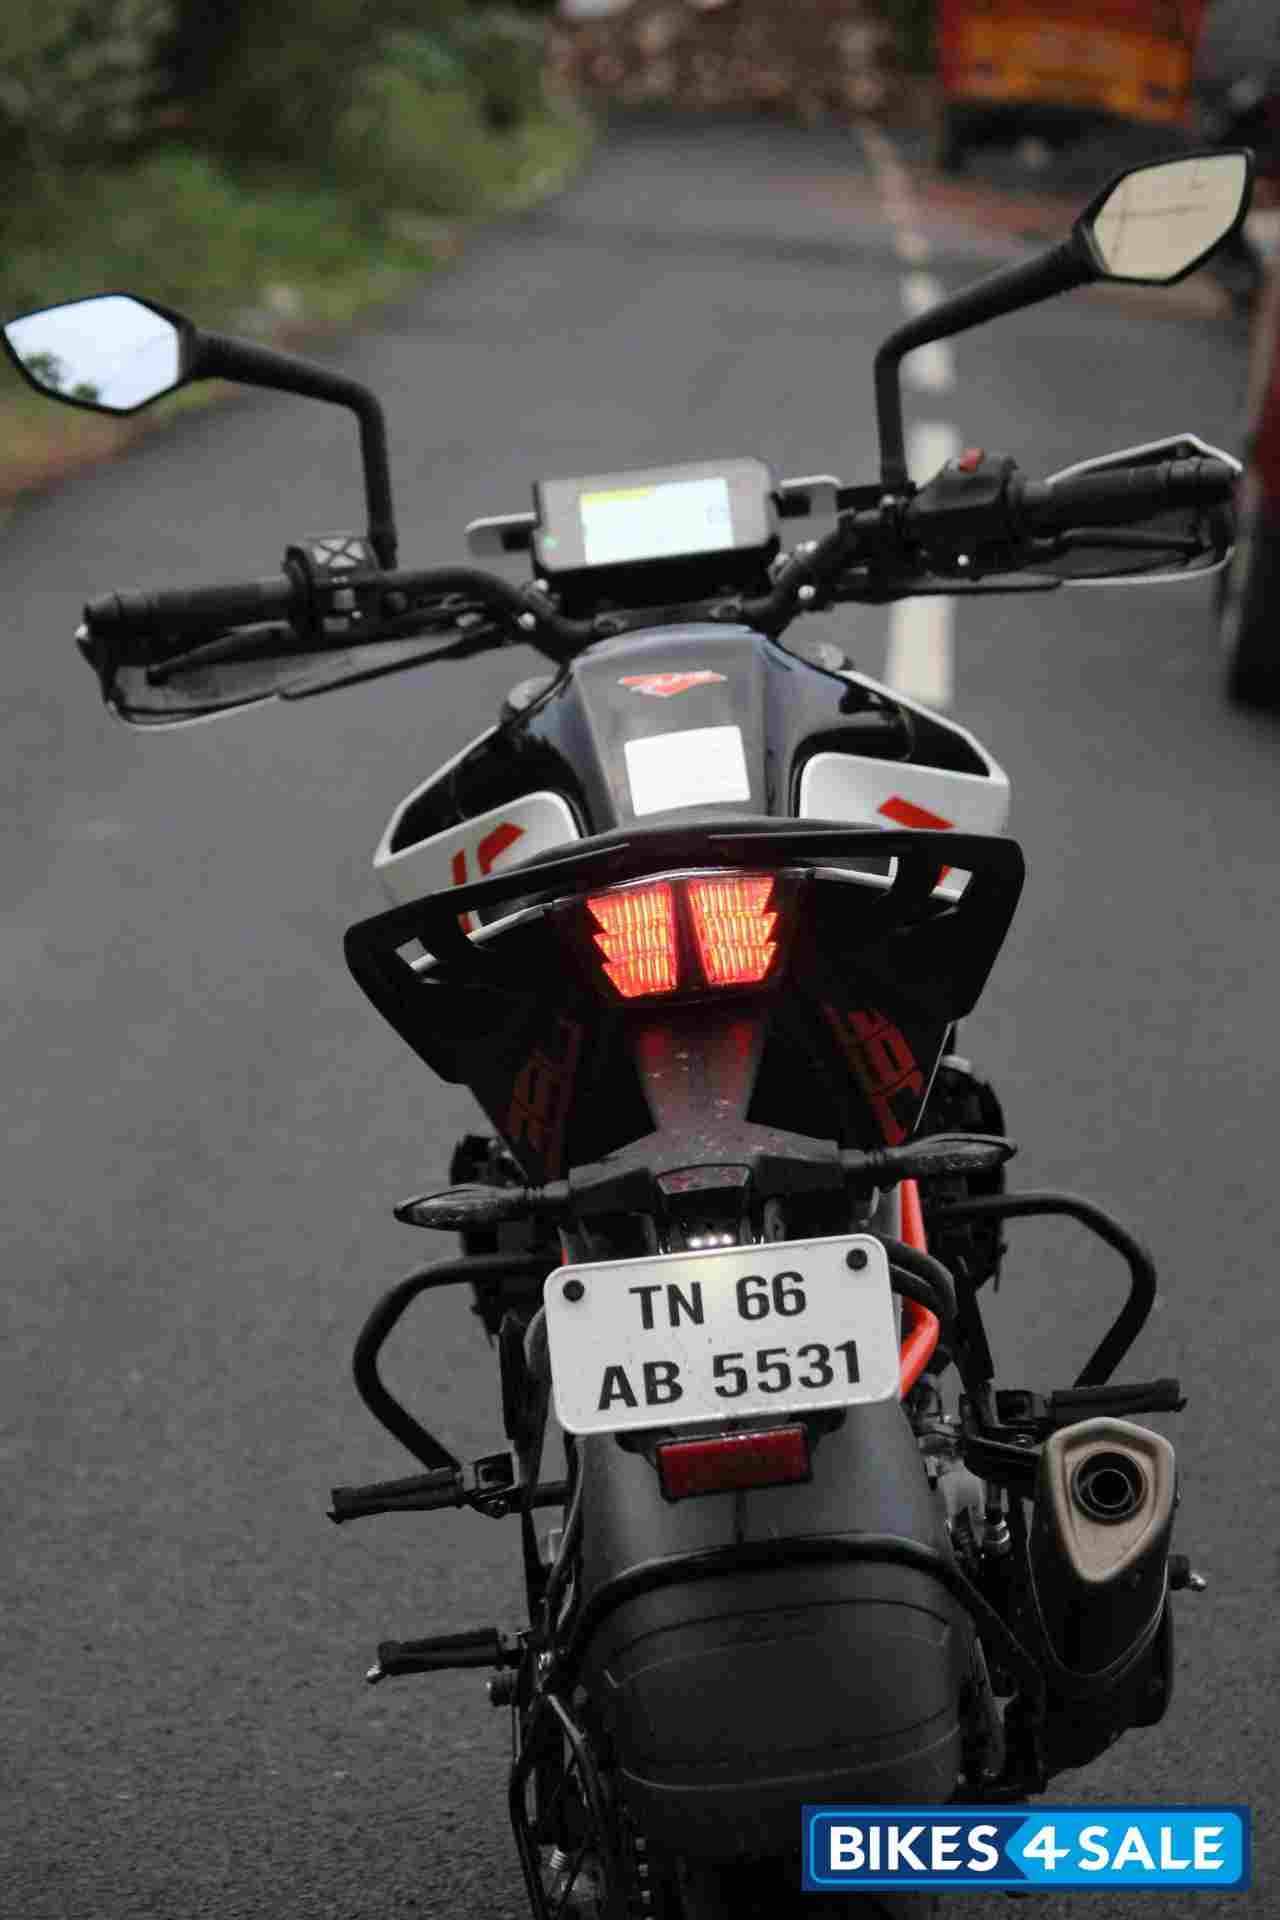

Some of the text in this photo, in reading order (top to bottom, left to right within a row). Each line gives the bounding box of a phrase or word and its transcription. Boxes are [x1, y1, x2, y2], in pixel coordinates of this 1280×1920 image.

[629, 1271, 807, 1330] TN 66
[597, 1340, 861, 1411] AB 5531
